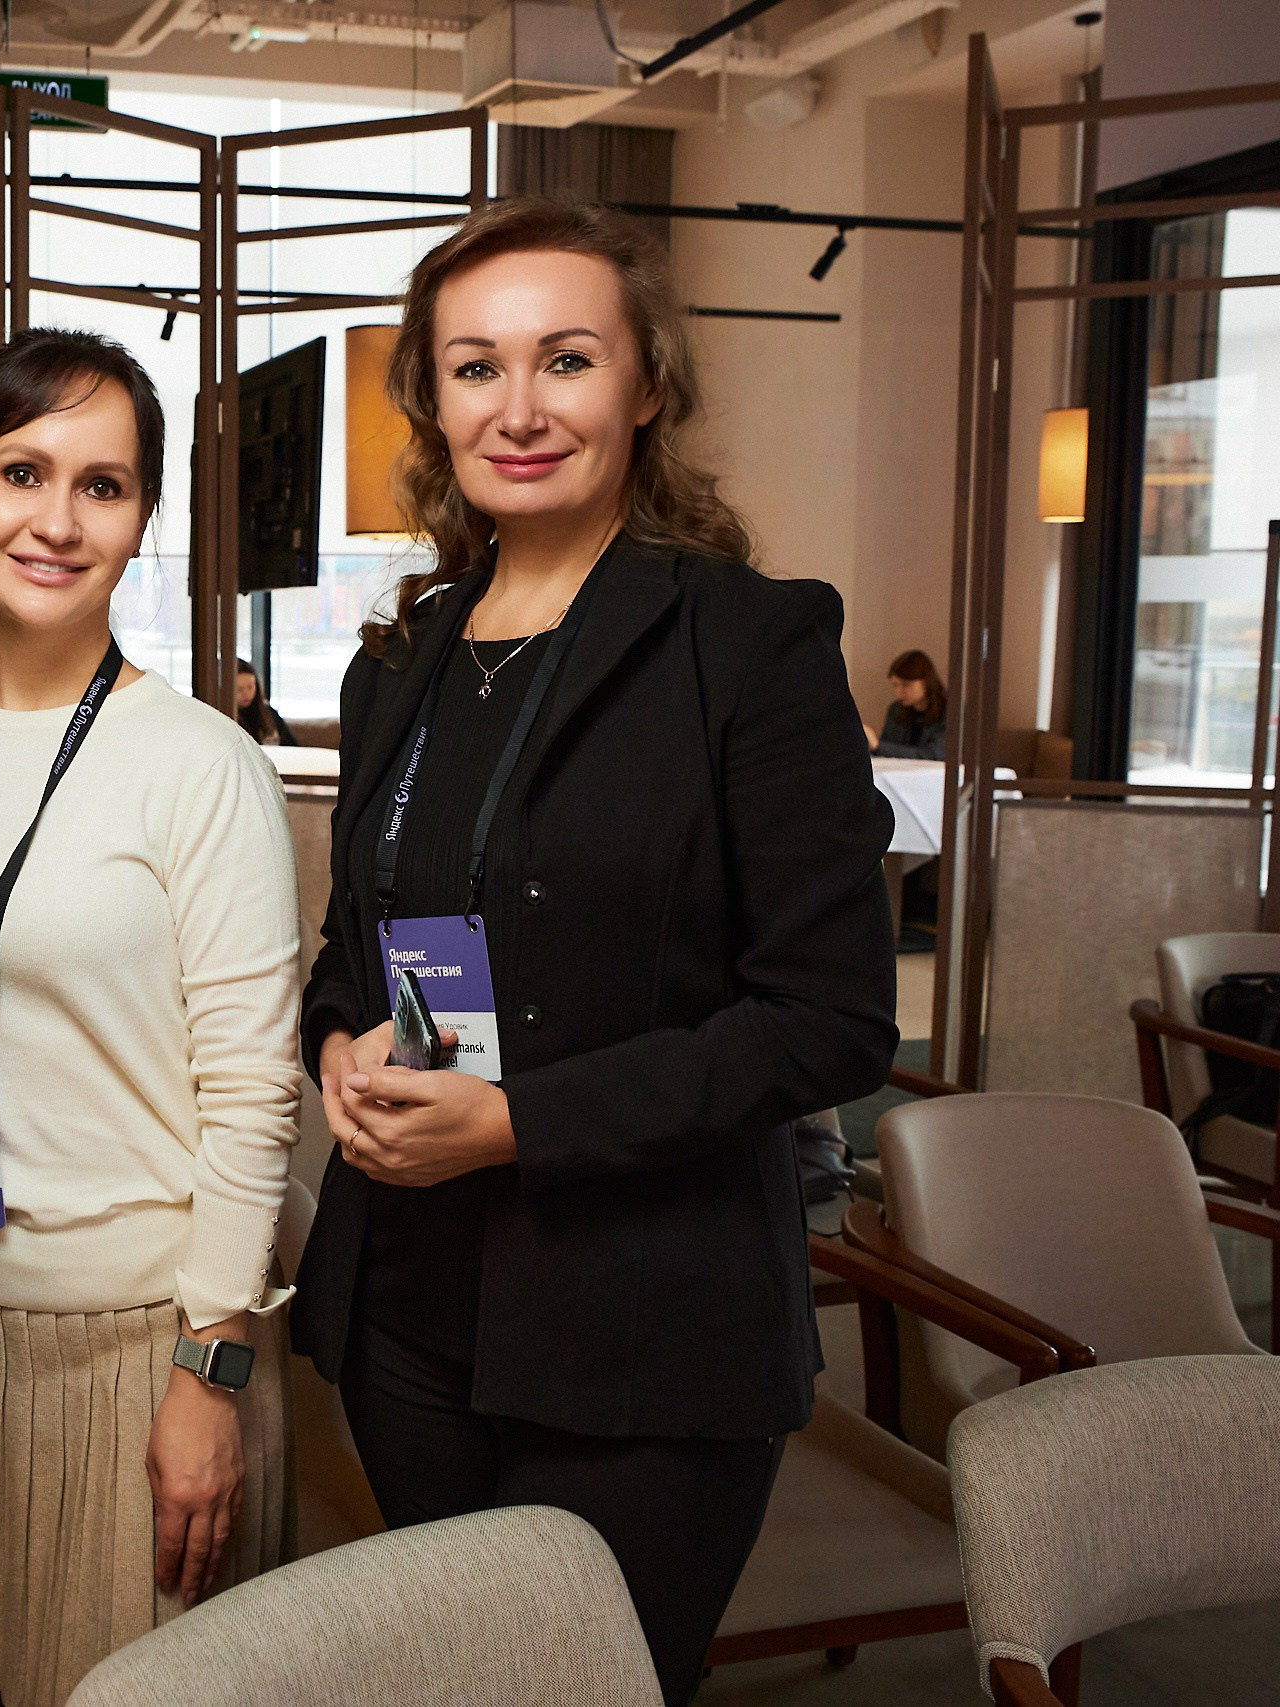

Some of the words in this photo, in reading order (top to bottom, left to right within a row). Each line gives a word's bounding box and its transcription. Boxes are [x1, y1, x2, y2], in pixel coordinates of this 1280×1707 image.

[84, 676, 107, 705] Яндекс
[53, 713, 87, 775] Путешествия
[385, 804, 405, 841] Яндекс
[399, 726, 428, 791] Путешествия
[389, 948, 427, 963] Яндекс
